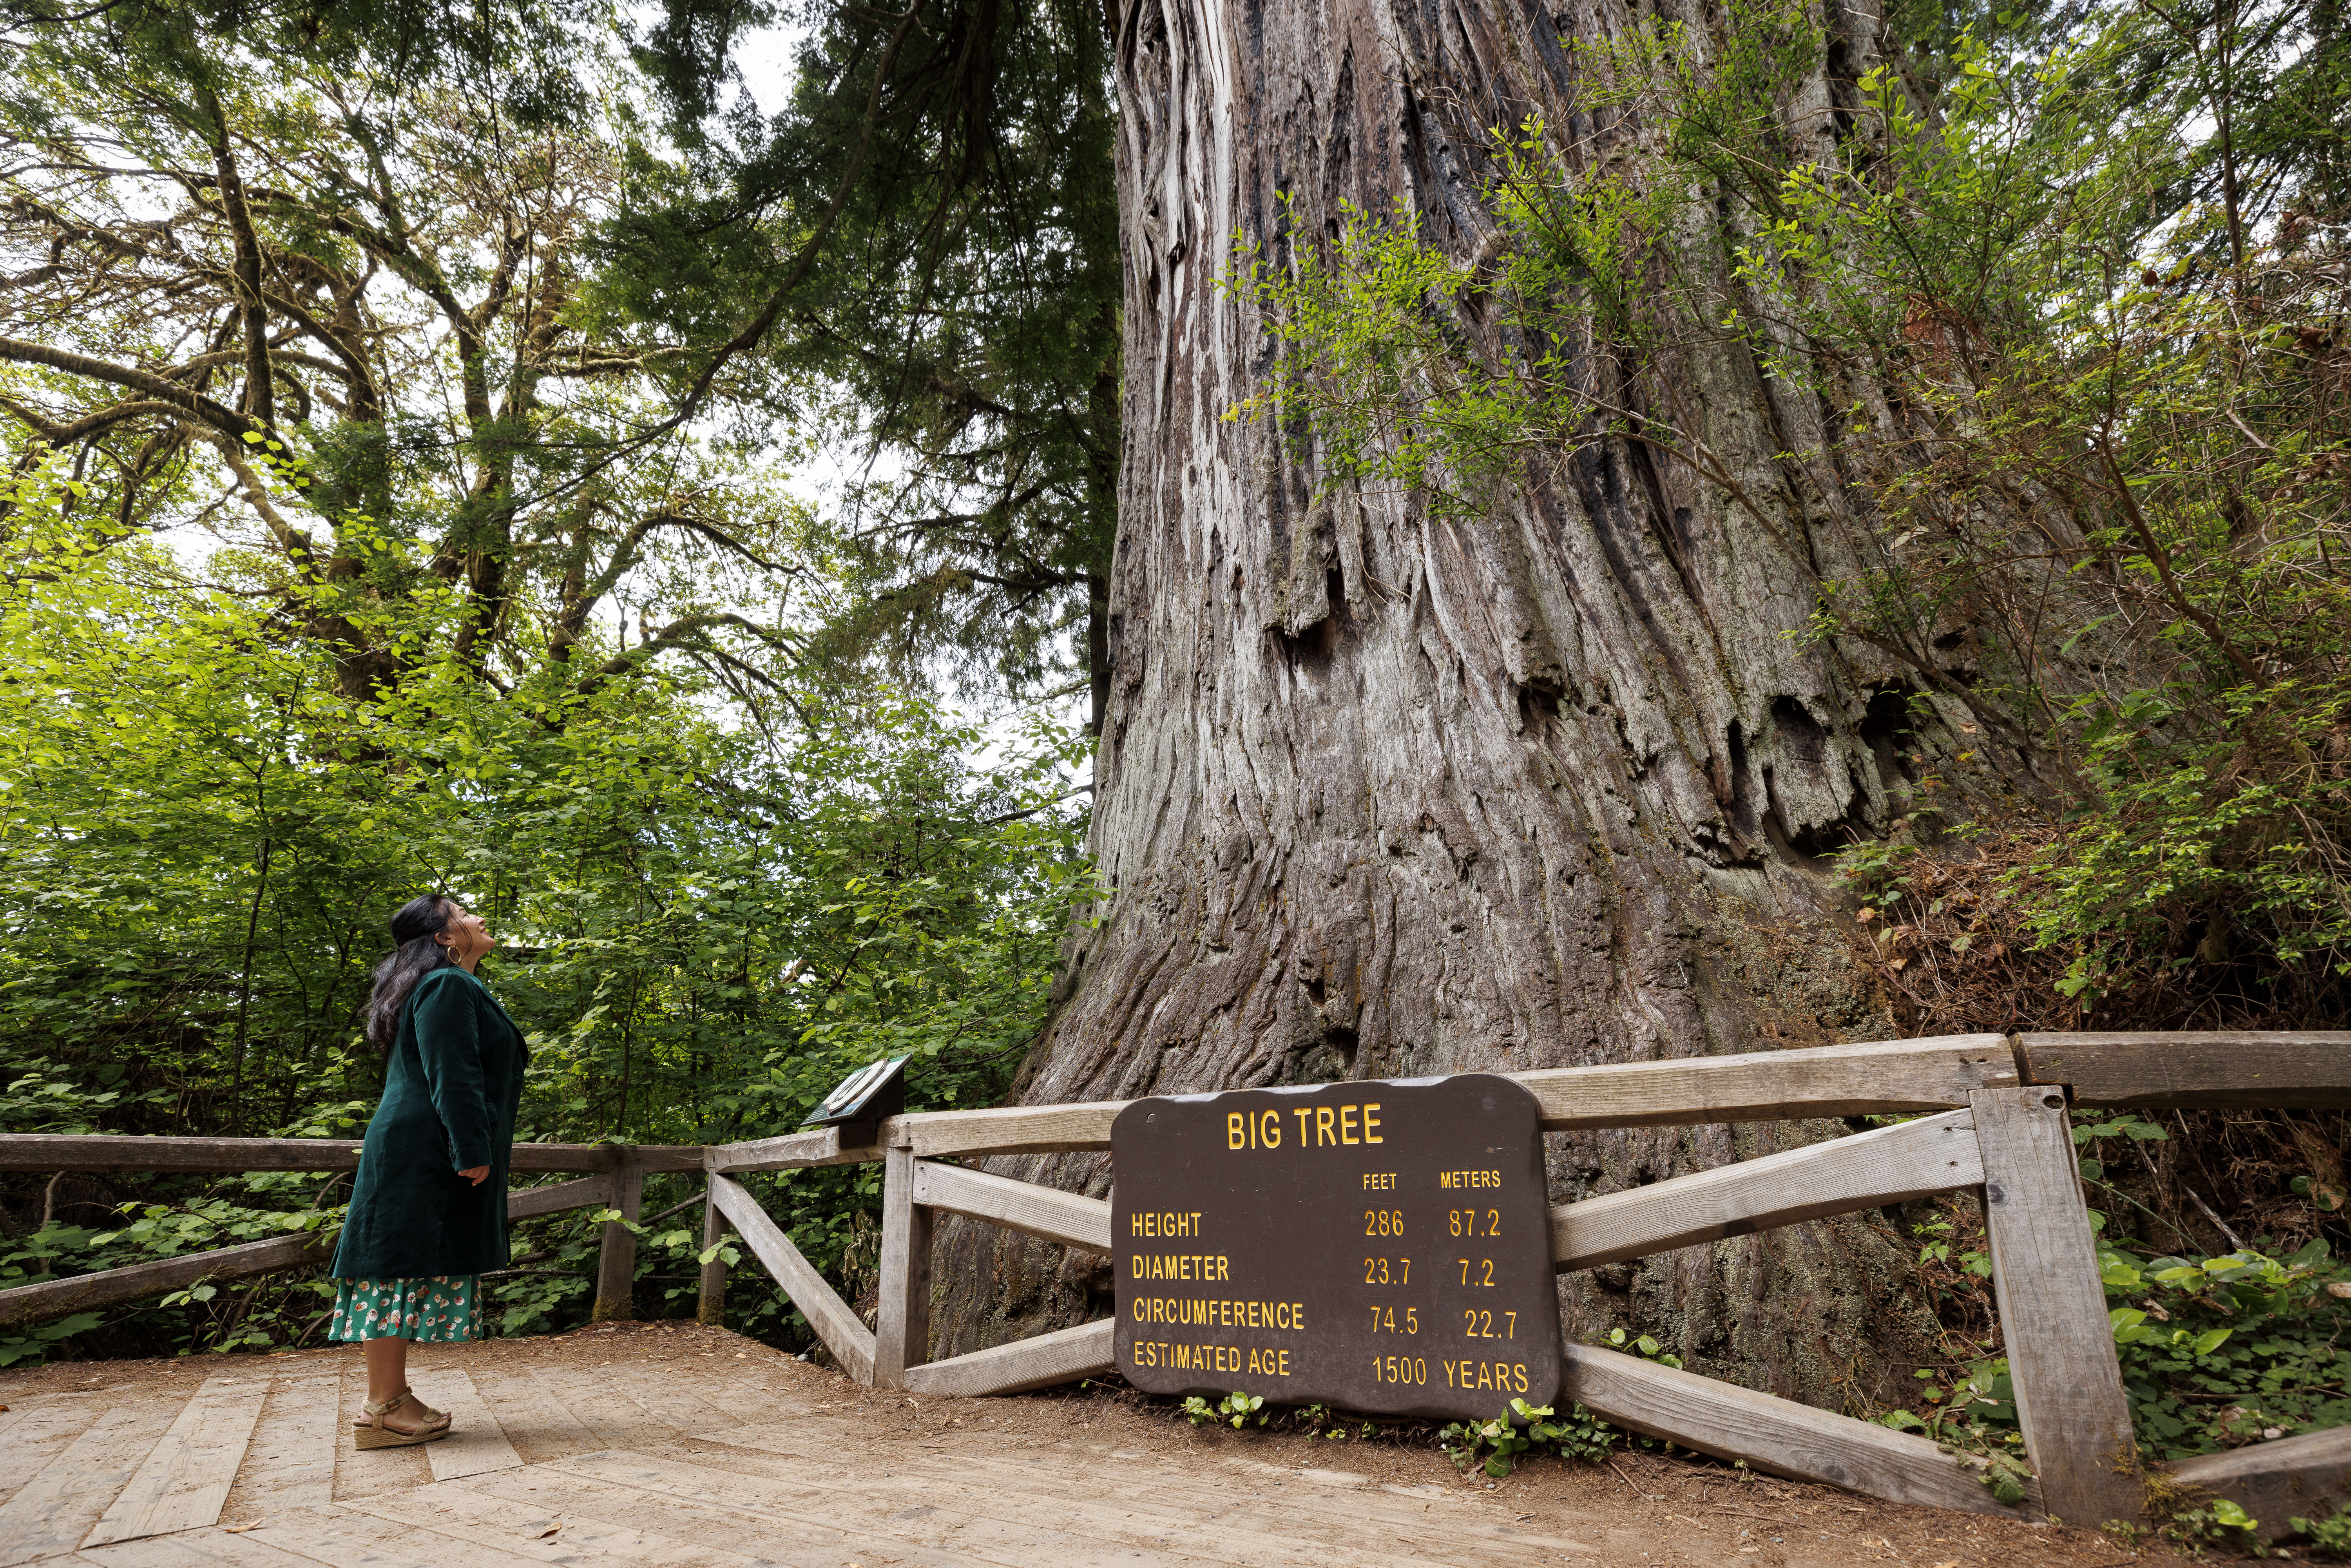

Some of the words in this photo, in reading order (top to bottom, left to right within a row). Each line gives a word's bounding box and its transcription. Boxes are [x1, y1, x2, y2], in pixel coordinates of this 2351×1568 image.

[1228, 1109, 1281, 1150] BIG
[1293, 1103, 1383, 1147] TREE
[1363, 1173, 1397, 1190] FEET
[1440, 1170, 1500, 1188] METERS
[1132, 1212, 1201, 1235] HEIGHT
[1365, 1209, 1404, 1235] 286
[1449, 1208, 1501, 1235] 87.2
[1133, 1254, 1229, 1280] DIAMETER
[1364, 1257, 1411, 1284] 23.7
[1458, 1258, 1495, 1286] 7.2
[1133, 1296, 1304, 1328] CIRCUMFERENCE
[1370, 1305, 1418, 1333] 74.5
[1465, 1308, 1516, 1338] 22.7
[1134, 1340, 1241, 1371] ESTIMATED
[1248, 1347, 1290, 1375] AGE
[1373, 1356, 1426, 1384] 1500
[1443, 1360, 1528, 1392] YEARS
